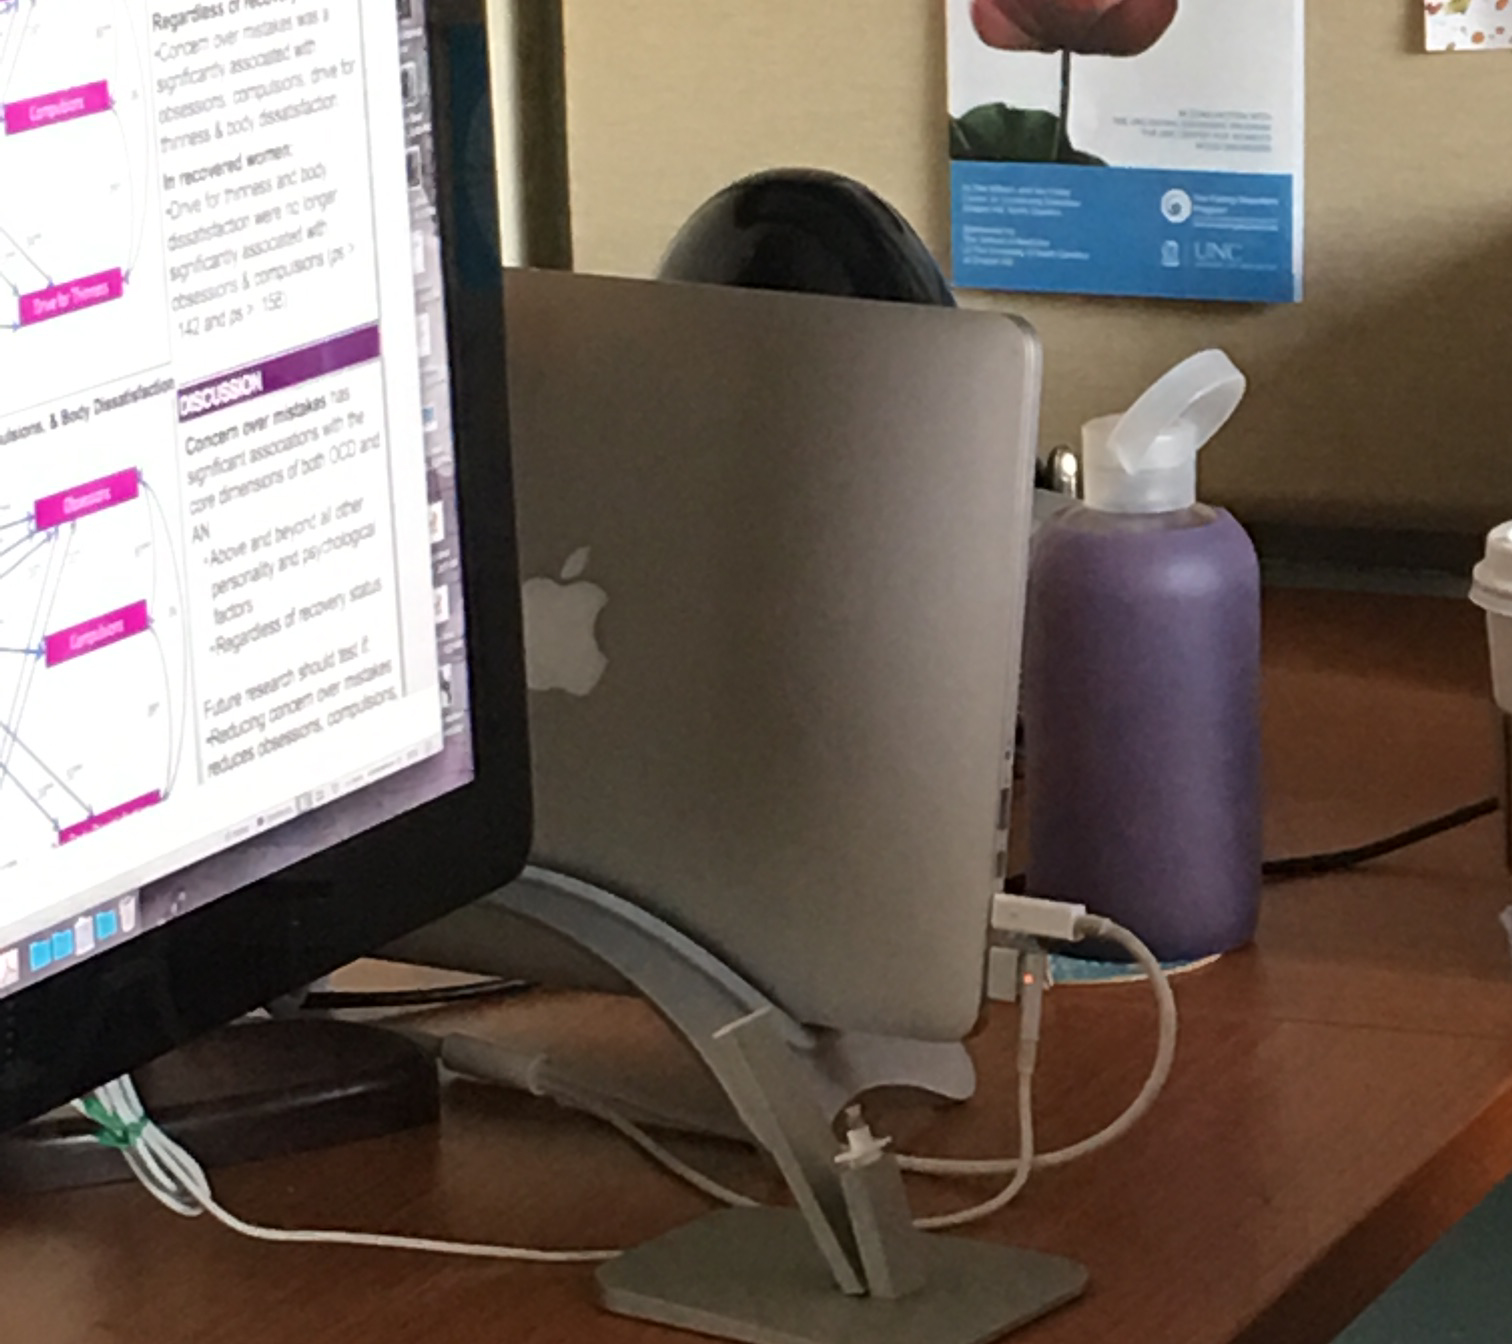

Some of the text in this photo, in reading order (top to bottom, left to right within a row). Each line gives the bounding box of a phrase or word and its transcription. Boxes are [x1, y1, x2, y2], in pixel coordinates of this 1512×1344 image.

[152, 2, 224, 32] Regardless
[214, 30, 240, 49] over
[229, 43, 291, 74] associated
[294, 38, 316, 58] with
[340, 58, 356, 75] for
[162, 173, 176, 191] In
[179, 153, 242, 186] recovered
[204, 190, 221, 209] for
[276, 170, 298, 190] and
[242, 226, 302, 260] associated
[306, 219, 328, 240] with
[1194, 240, 1243, 262] UNC
[204, 312, 226, 332] and
[50, 412, 58, 430] &
[60, 405, 90, 426] Body
[94, 377, 176, 416] Dissatisfaction
[178, 370, 264, 416] DISCUSSION
[185, 426, 240, 456] Concern
[242, 414, 270, 436] over
[273, 396, 326, 426] mistakes
[187, 450, 247, 488] significant
[250, 426, 319, 464] associations
[322, 416, 344, 436] with
[190, 432, 380, 516] core dimensions of both OCD and
[192, 522, 210, 544] AN
[250, 528, 272, 552] and
[274, 514, 316, 544] beyond
[212, 520, 376, 600] personality and psychological
[213, 598, 254, 626] factors
[284, 607, 296, 628] of
[299, 592, 346, 622] recovery
[203, 692, 242, 719] Future
[246, 668, 296, 702] research
[298, 651, 336, 682] should
[268, 692, 314, 724] concern
[316, 680, 342, 702] over
[344, 659, 392, 690] mistakes
[206, 746, 256, 778] reduces
